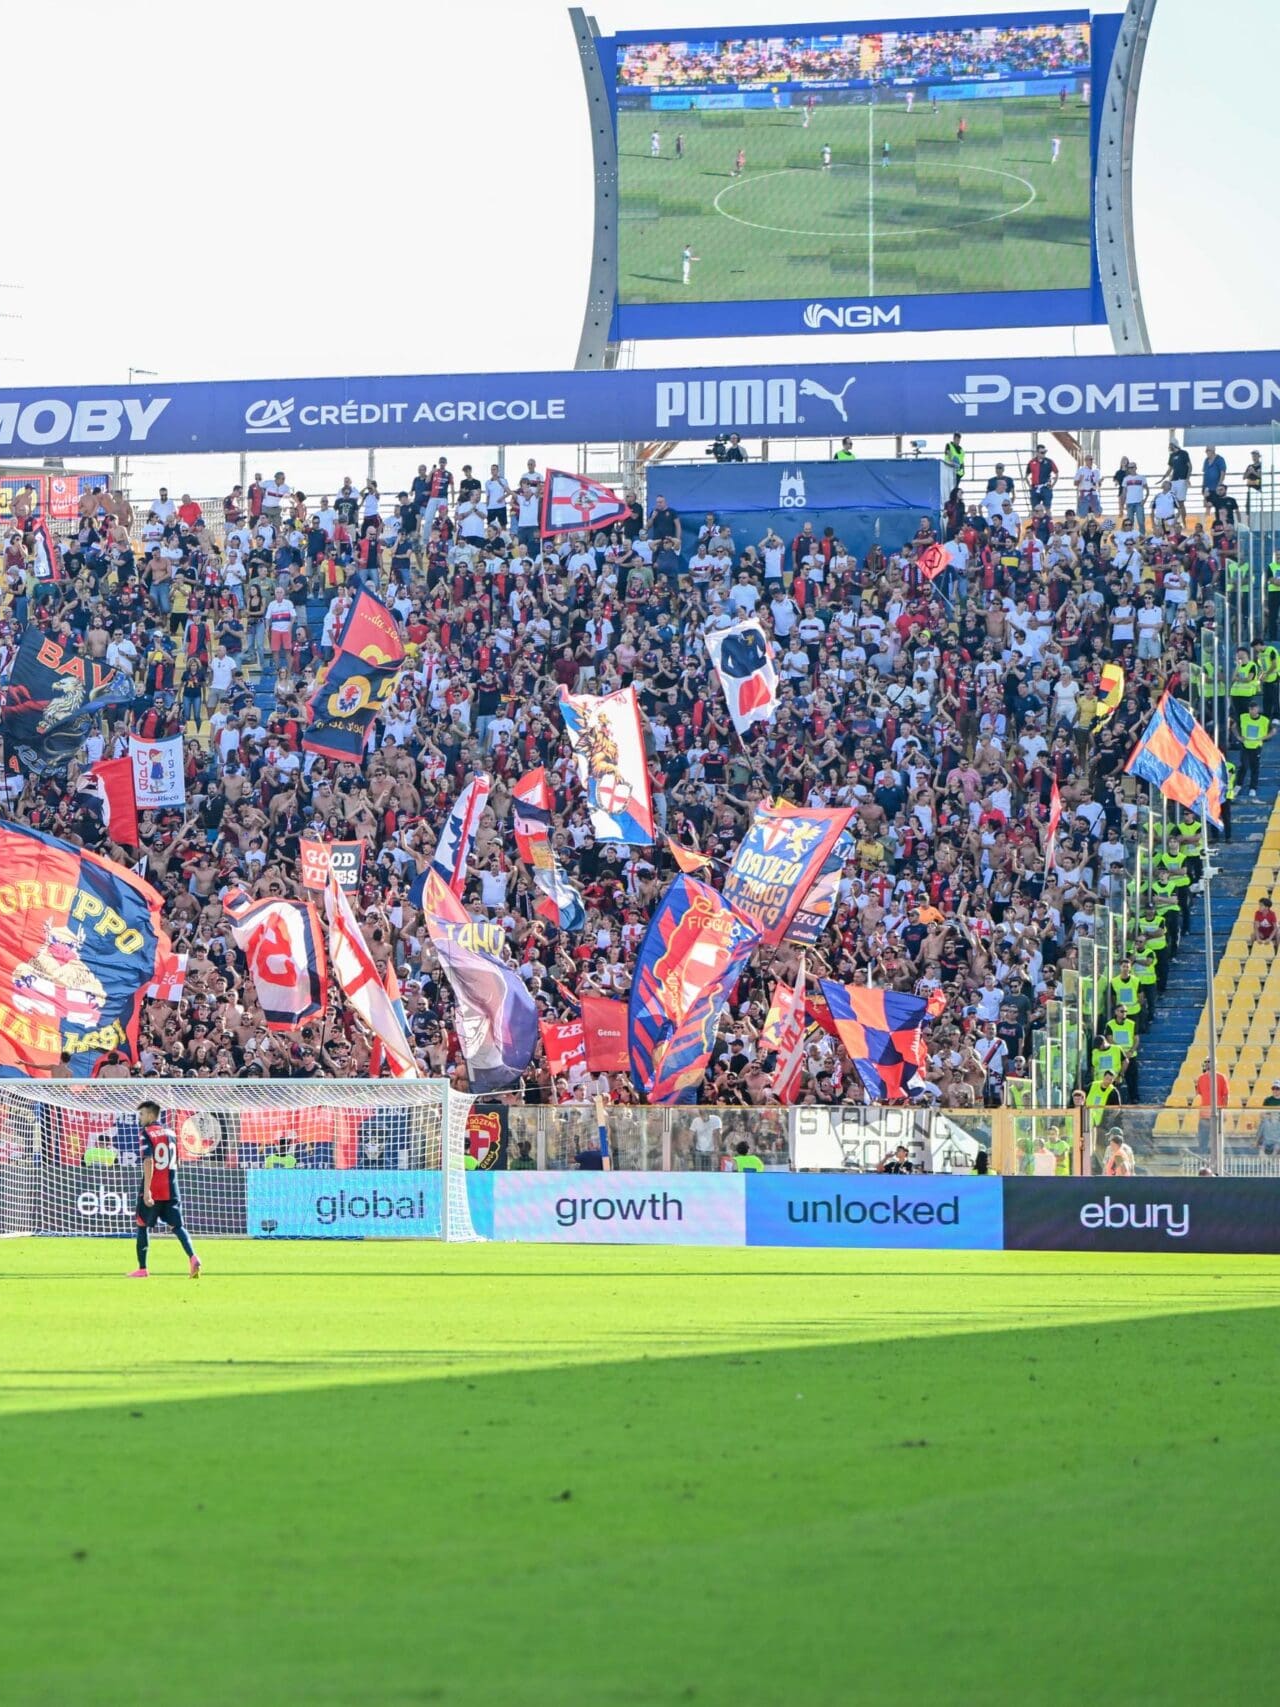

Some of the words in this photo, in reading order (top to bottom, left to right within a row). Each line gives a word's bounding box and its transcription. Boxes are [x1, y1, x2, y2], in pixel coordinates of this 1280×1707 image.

[820, 304, 901, 328] NGM
[299, 400, 409, 426] CRÉDIT
[413, 399, 566, 423] AGRICOLE
[656, 378, 797, 427] PUMA
[779, 496, 807, 508] 100
[306, 849, 356, 868] GOOD
[303, 865, 358, 885] VIES
[154, 1142, 178, 1171] 92
[842, 1140, 926, 1168] ZOE
[77, 1184, 137, 1216] ebu
[316, 1189, 425, 1225] global
[554, 1191, 684, 1227] growth
[786, 1194, 961, 1225] unlocked
[1079, 1195, 1191, 1237] ebury
